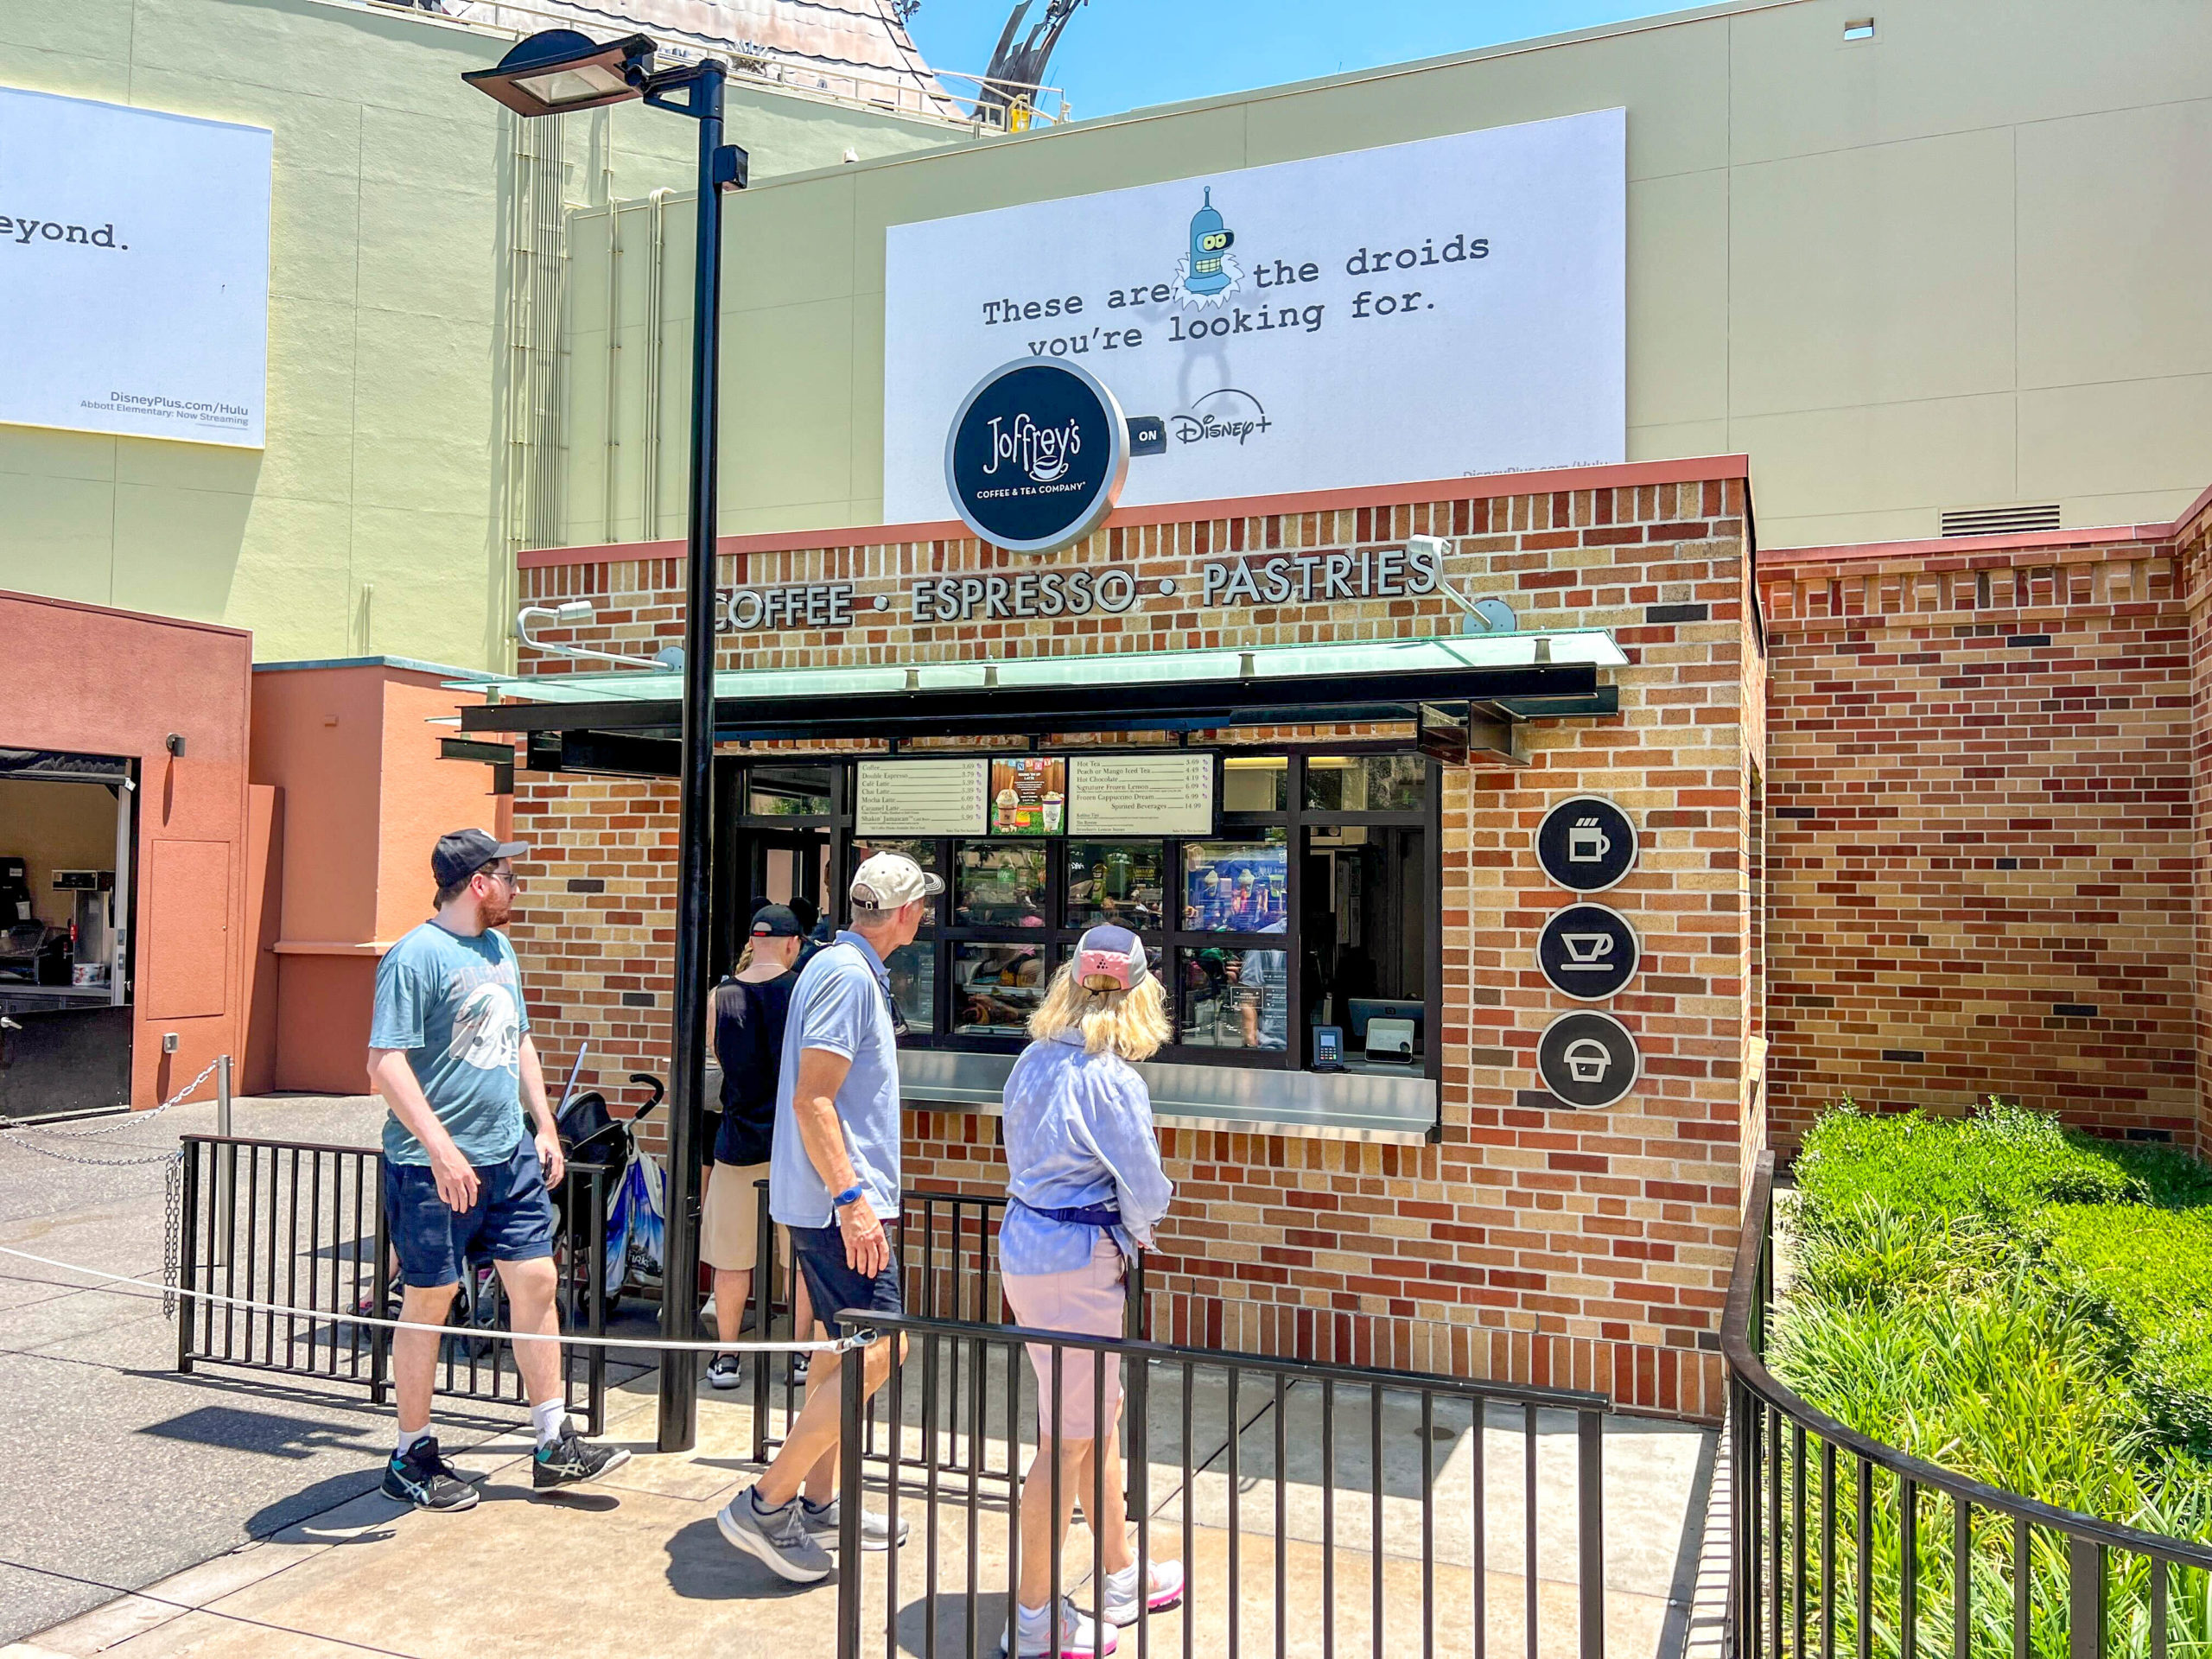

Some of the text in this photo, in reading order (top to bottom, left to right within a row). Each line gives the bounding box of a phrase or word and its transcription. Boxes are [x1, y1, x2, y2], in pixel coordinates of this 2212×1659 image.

[982, 293, 1084, 325] These
[1253, 259, 1320, 289] the
[1345, 233, 1491, 276] droids
[1028, 288, 1436, 357] you're looking for.
[80, 400, 249, 426] Abbott Elementary: Now Streaming
[111, 391, 249, 416] DisneyPlus.com/Hulu
[982, 413, 1082, 474] Joffrey's
[1138, 429, 1157, 442] ON
[976, 489, 1010, 499] COFFEE
[1020, 486, 1037, 495] TEA
[912, 569, 1136, 622] ESPRESSO
[1203, 550, 1439, 607] PASTRIES
[1111, 803, 1135, 811] Spirited
[1136, 803, 1167, 811] Beverages
